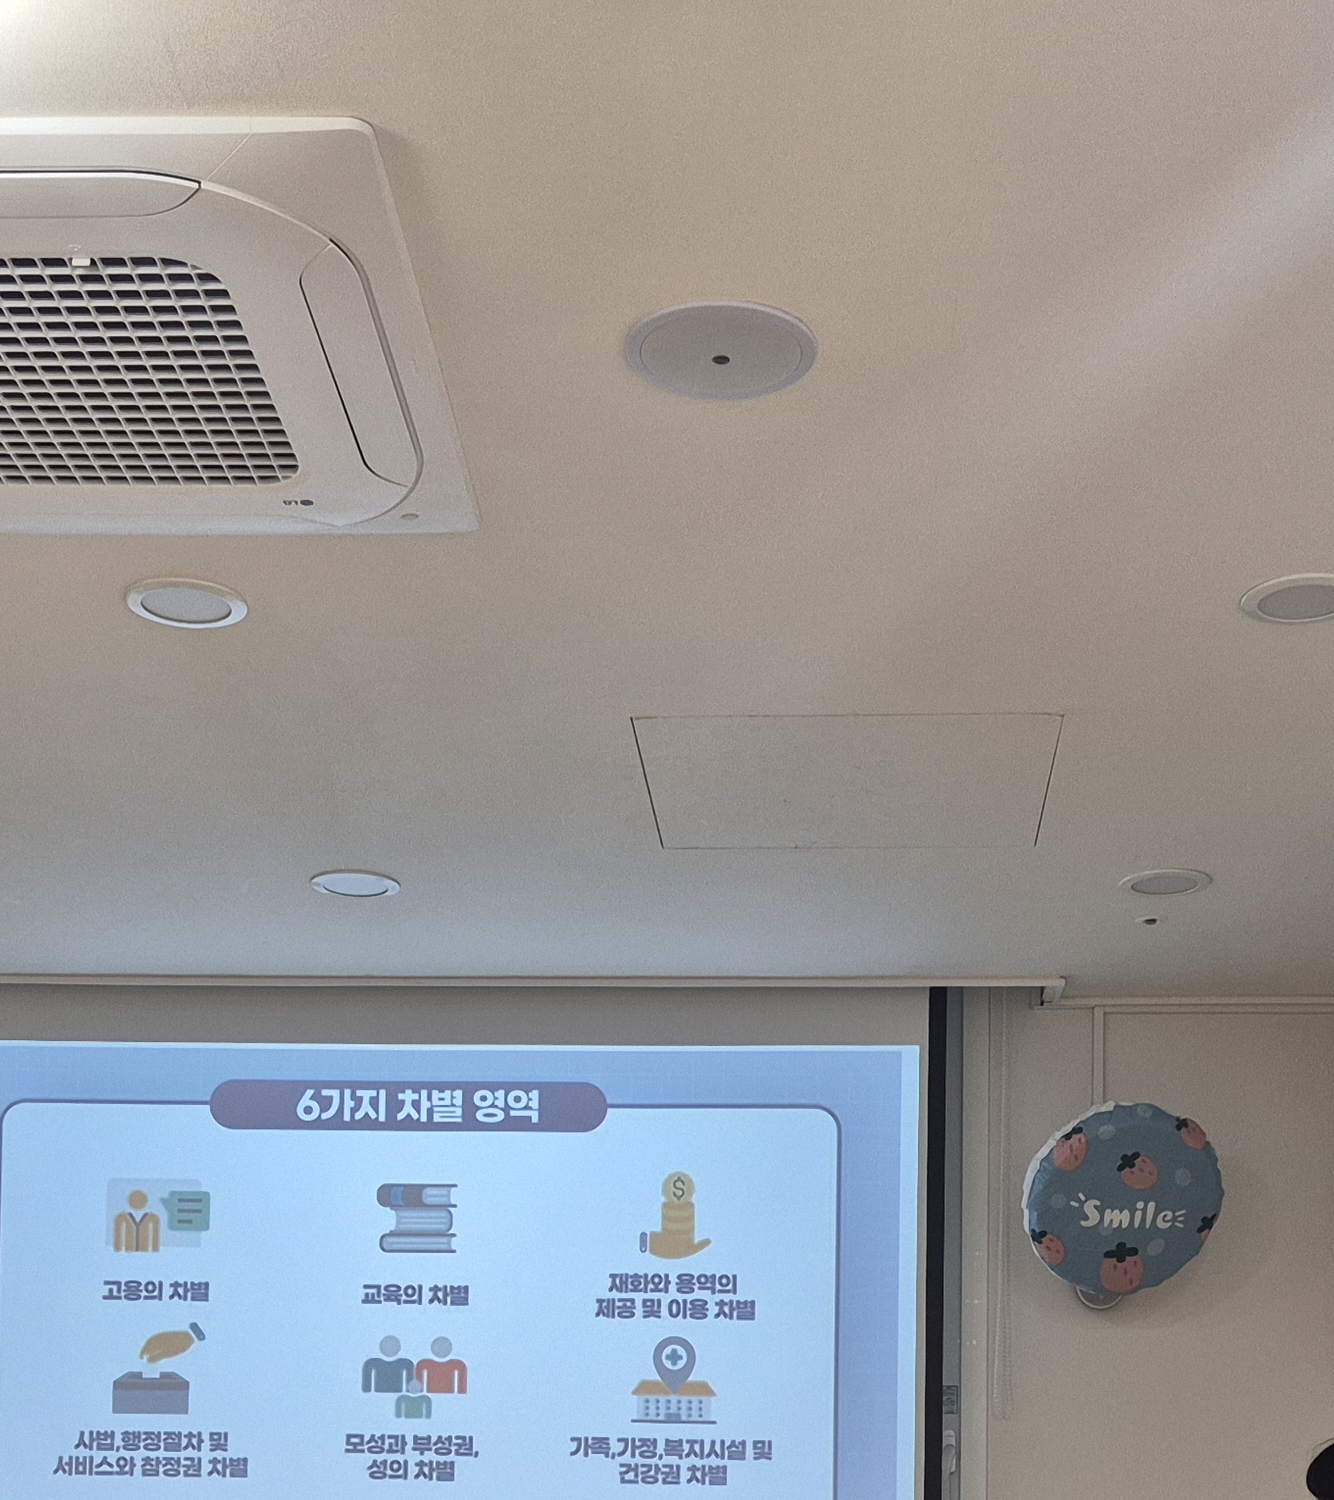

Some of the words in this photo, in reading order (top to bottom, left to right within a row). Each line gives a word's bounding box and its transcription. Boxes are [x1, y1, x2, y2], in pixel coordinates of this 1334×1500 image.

[296, 1088, 387, 1122] 6가지
[397, 1089, 463, 1123] 차별
[473, 1089, 540, 1123] 영역
[1080, 1199, 1174, 1229] Smile
[101, 1280, 163, 1301] 고용의
[169, 1280, 209, 1302] 차별
[361, 1284, 423, 1305] 교육의
[428, 1284, 469, 1306] 차별
[608, 1273, 671, 1294] 재화와
[675, 1273, 738, 1295] 용역의
[595, 1298, 636, 1319] 제공
[641, 1298, 662, 1319] 및
[668, 1299, 709, 1320] 이용
[714, 1299, 756, 1321] 차별
[74, 1430, 204, 1453] 사법,행정절차
[209, 1431, 228, 1452] 및
[344, 1433, 408, 1455] 모성과
[411, 1434, 479, 1458] 부성권,
[569, 1436, 747, 1460] 가족,가정,복지시설
[752, 1439, 772, 1461] 및
[53, 1456, 136, 1477] 서비스와
[141, 1456, 202, 1478] 참정권
[207, 1457, 248, 1478] 차별
[367, 1458, 408, 1480] 성의
[414, 1459, 455, 1482] 차별
[618, 1463, 681, 1485] 건강권
[686, 1464, 728, 1485] 차별
